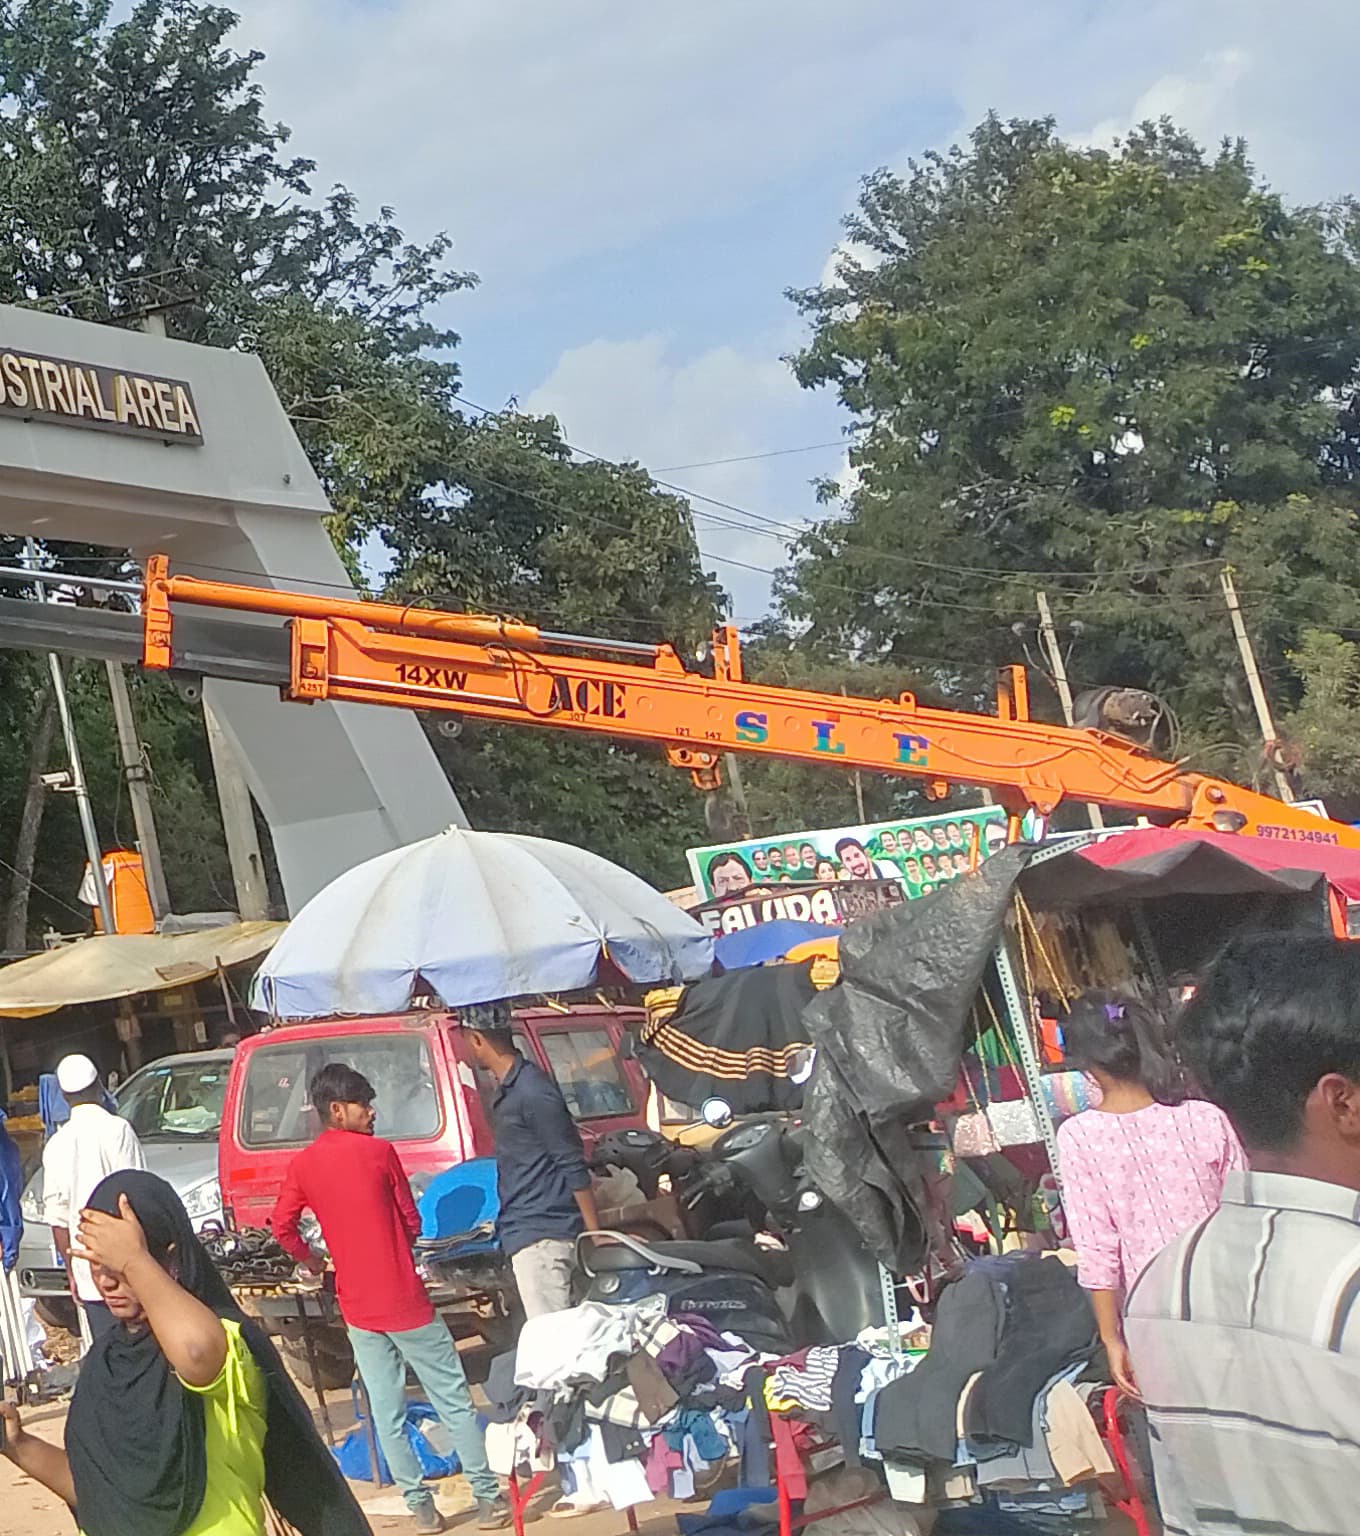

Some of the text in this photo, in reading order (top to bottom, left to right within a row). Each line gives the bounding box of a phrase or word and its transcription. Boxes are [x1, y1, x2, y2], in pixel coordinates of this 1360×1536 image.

[115, 375, 201, 435] AREA
[395, 664, 468, 690] 14XW
[548, 675, 627, 718] ACE
[1256, 824, 1338, 845] 9972134941
